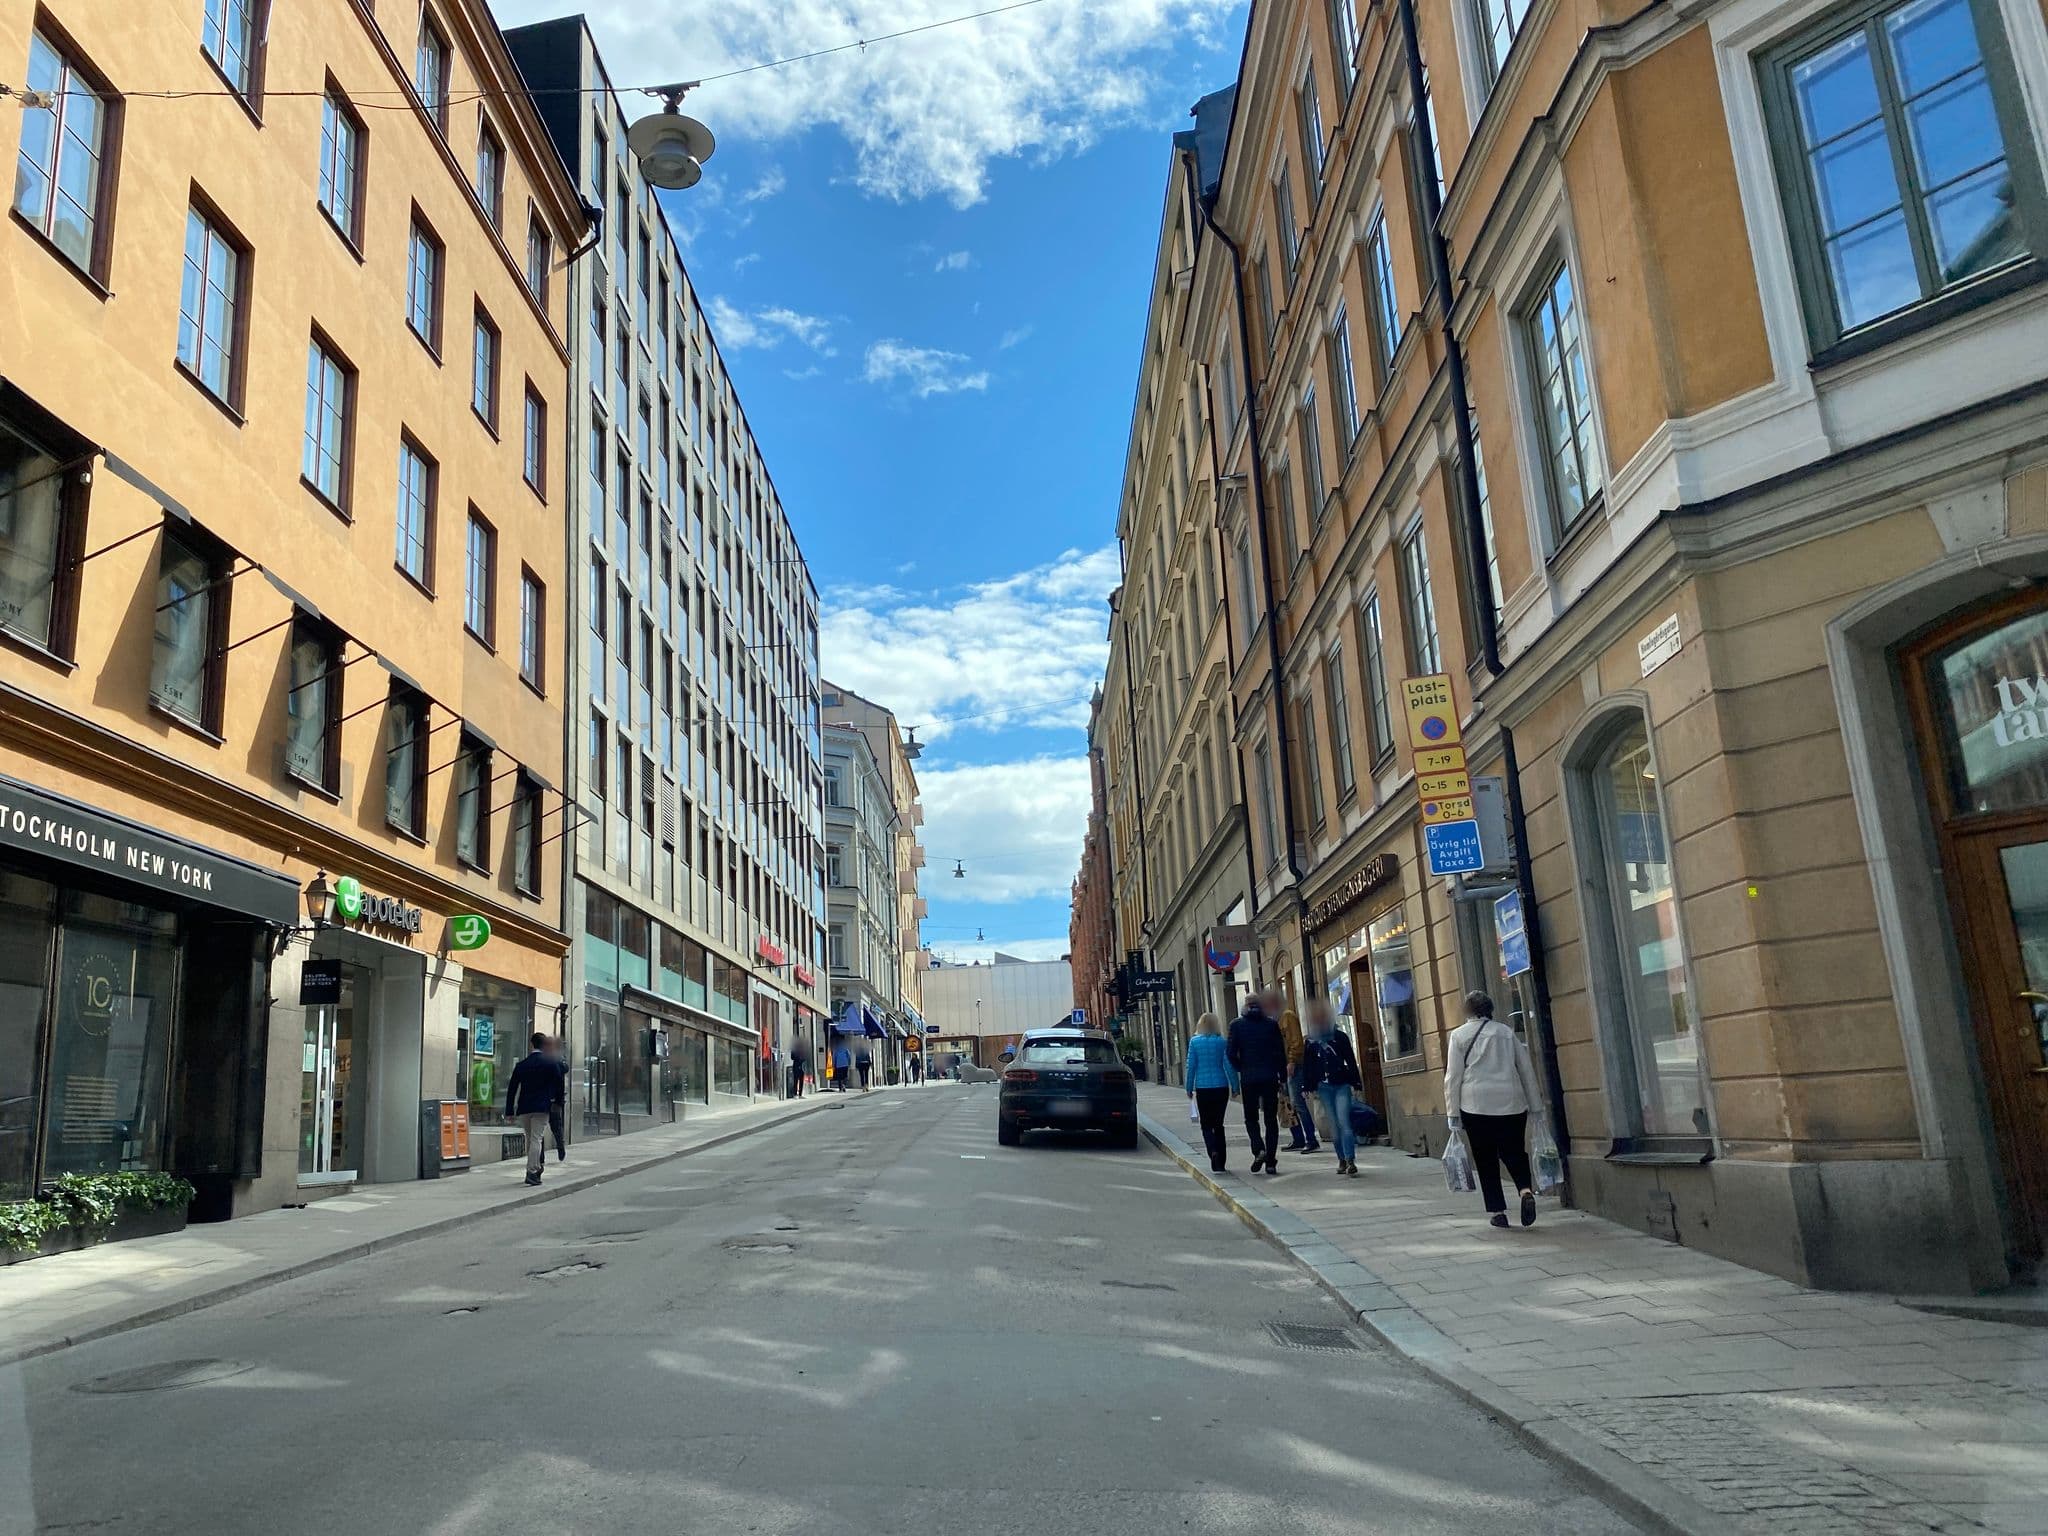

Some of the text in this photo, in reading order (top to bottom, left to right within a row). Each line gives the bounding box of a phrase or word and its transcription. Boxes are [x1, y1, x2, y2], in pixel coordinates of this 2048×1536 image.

[1407, 681, 1446, 695] Last-
[1411, 694, 1448, 710] plats
[1427, 755, 1452, 767] 7-19
[1421, 780, 1467, 793] 0-15 m
[1438, 799, 1471, 811] Torsd
[1442, 810, 1465, 820] 0-6
[1430, 837, 1477, 850] Övrig tid
[1439, 848, 1472, 859] Avgift
[127, 846, 165, 876] NEW
[171, 860, 213, 891] YORK
[1439, 856, 1475, 869] Taxa 2
[360, 891, 423, 934] apoteket
